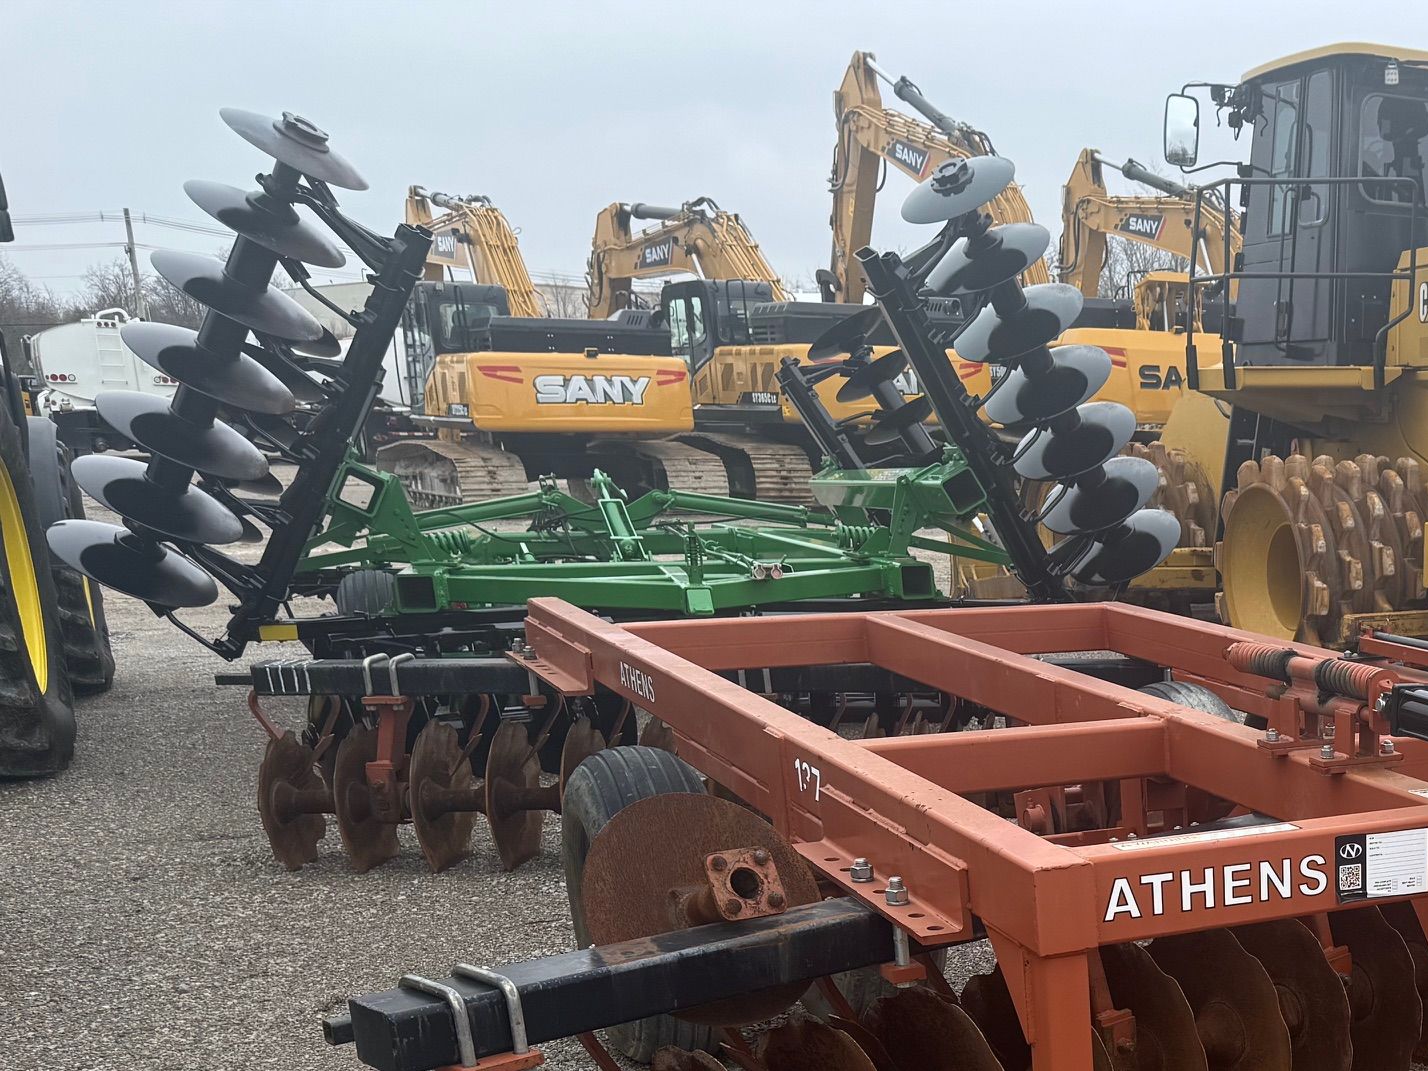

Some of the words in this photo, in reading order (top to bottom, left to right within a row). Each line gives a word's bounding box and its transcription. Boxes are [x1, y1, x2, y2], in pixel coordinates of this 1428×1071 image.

[895, 144, 924, 170] SANY
[1129, 217, 1158, 234] SANY
[437, 236, 455, 253] SANY
[644, 244, 670, 263] SANY
[533, 374, 652, 406] SANY
[620, 661, 656, 703] ATHENS
[1102, 853, 1329, 924] ATHENS
